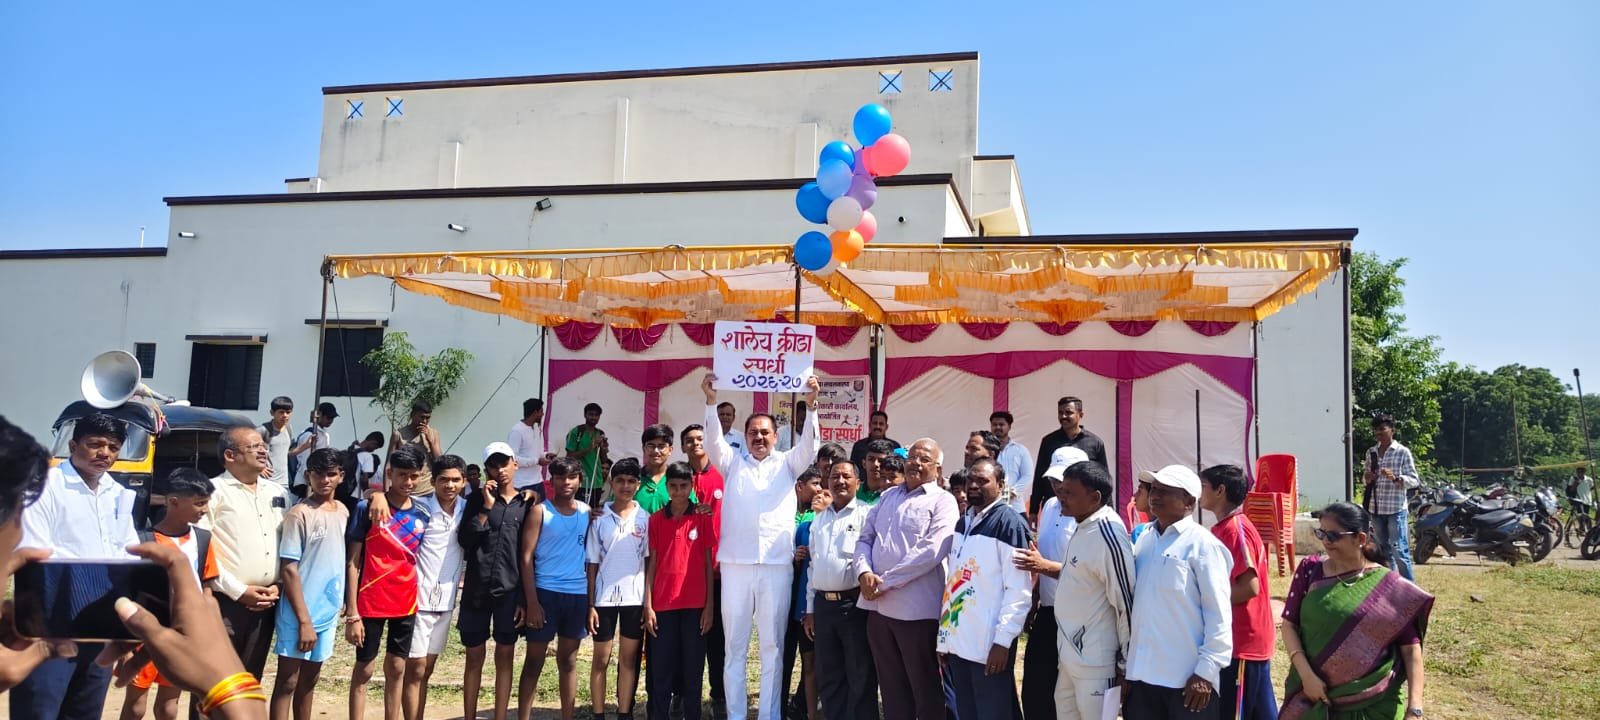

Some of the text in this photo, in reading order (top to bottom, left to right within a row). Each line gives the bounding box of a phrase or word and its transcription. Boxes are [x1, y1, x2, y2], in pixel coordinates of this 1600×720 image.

[721, 326, 813, 353] शालेय क्रीडा
[743, 353, 785, 374] स्पर्धा
[732, 374, 801, 392] २०२६-२७
[835, 424, 862, 441] स्पर्धा
